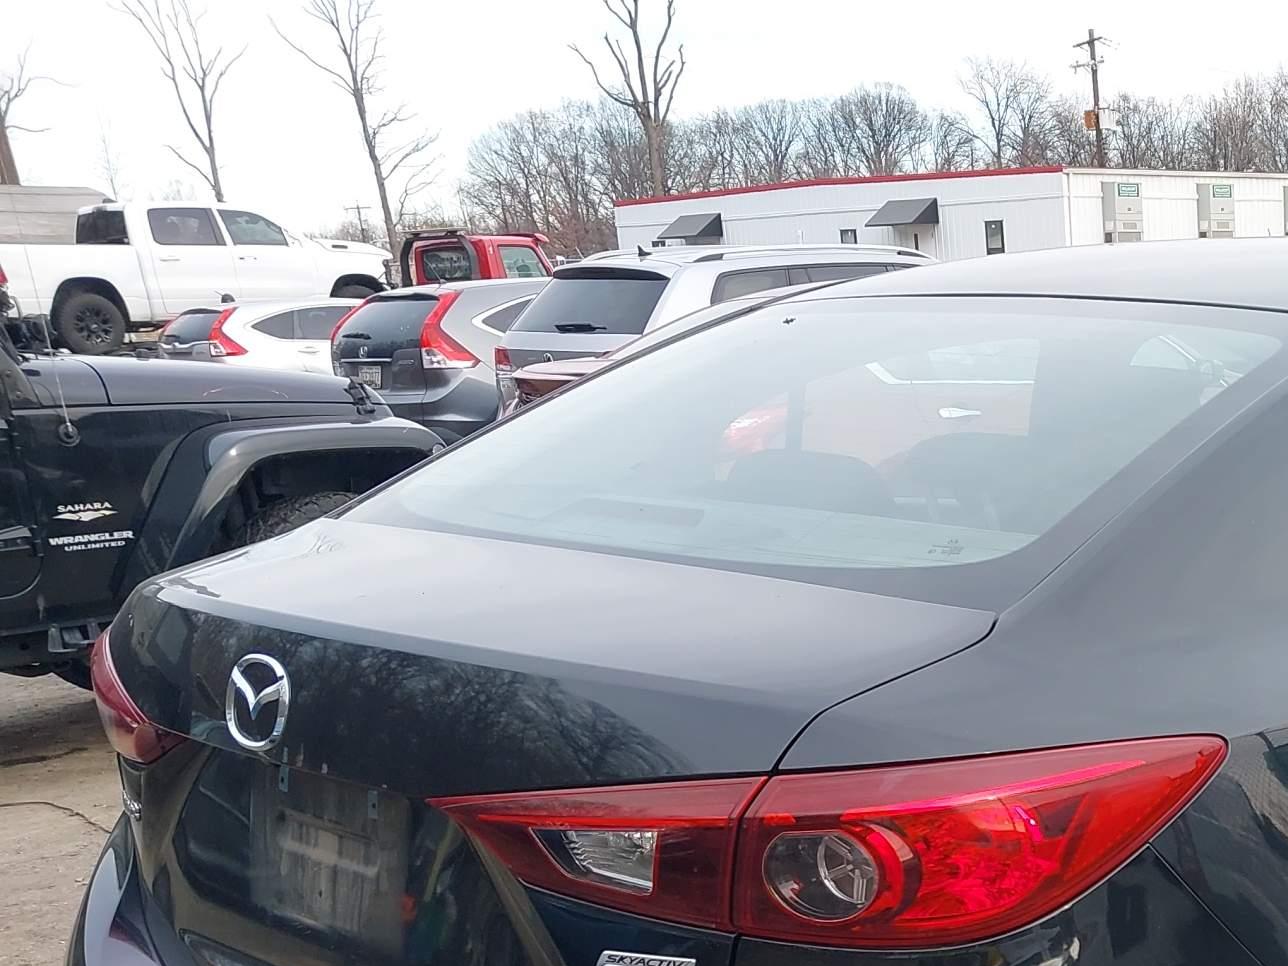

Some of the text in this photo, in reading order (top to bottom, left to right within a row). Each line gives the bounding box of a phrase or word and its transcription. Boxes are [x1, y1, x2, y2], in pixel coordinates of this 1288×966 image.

[57, 502, 112, 512] SAHARA
[48, 531, 135, 545] WRANGLER
[64, 541, 126, 551] UNLIMITED
